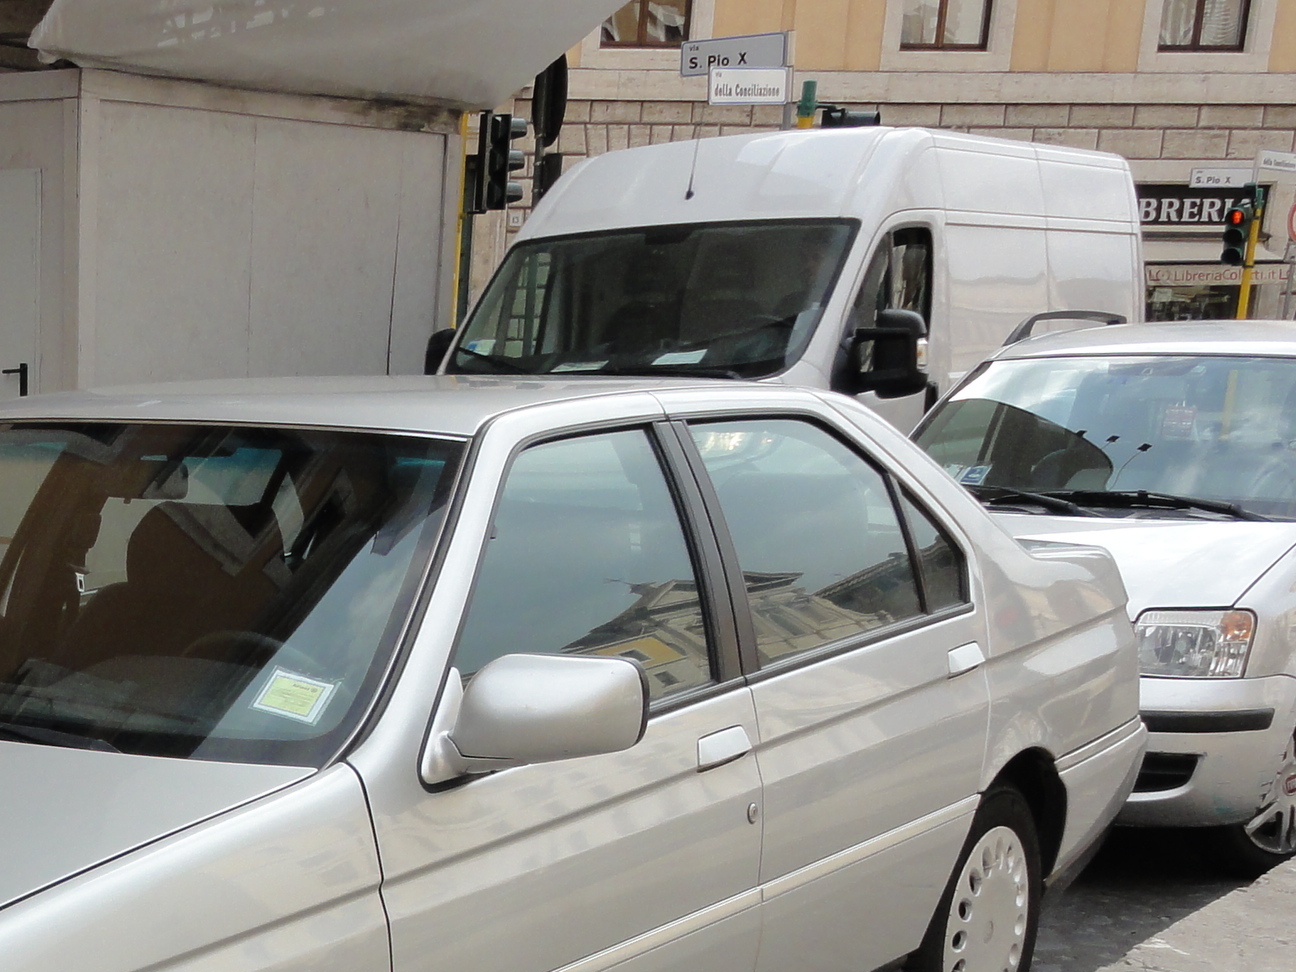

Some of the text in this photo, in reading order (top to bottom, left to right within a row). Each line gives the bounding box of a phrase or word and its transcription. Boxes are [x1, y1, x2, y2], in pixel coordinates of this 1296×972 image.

[689, 44, 699, 52] via
[689, 52, 747, 69] S. Pio X
[714, 83, 780, 97] della Conciliazione
[1206, 176, 1221, 184] Pio
[1225, 176, 1231, 184] X
[1139, 198, 1251, 222] BRERI
